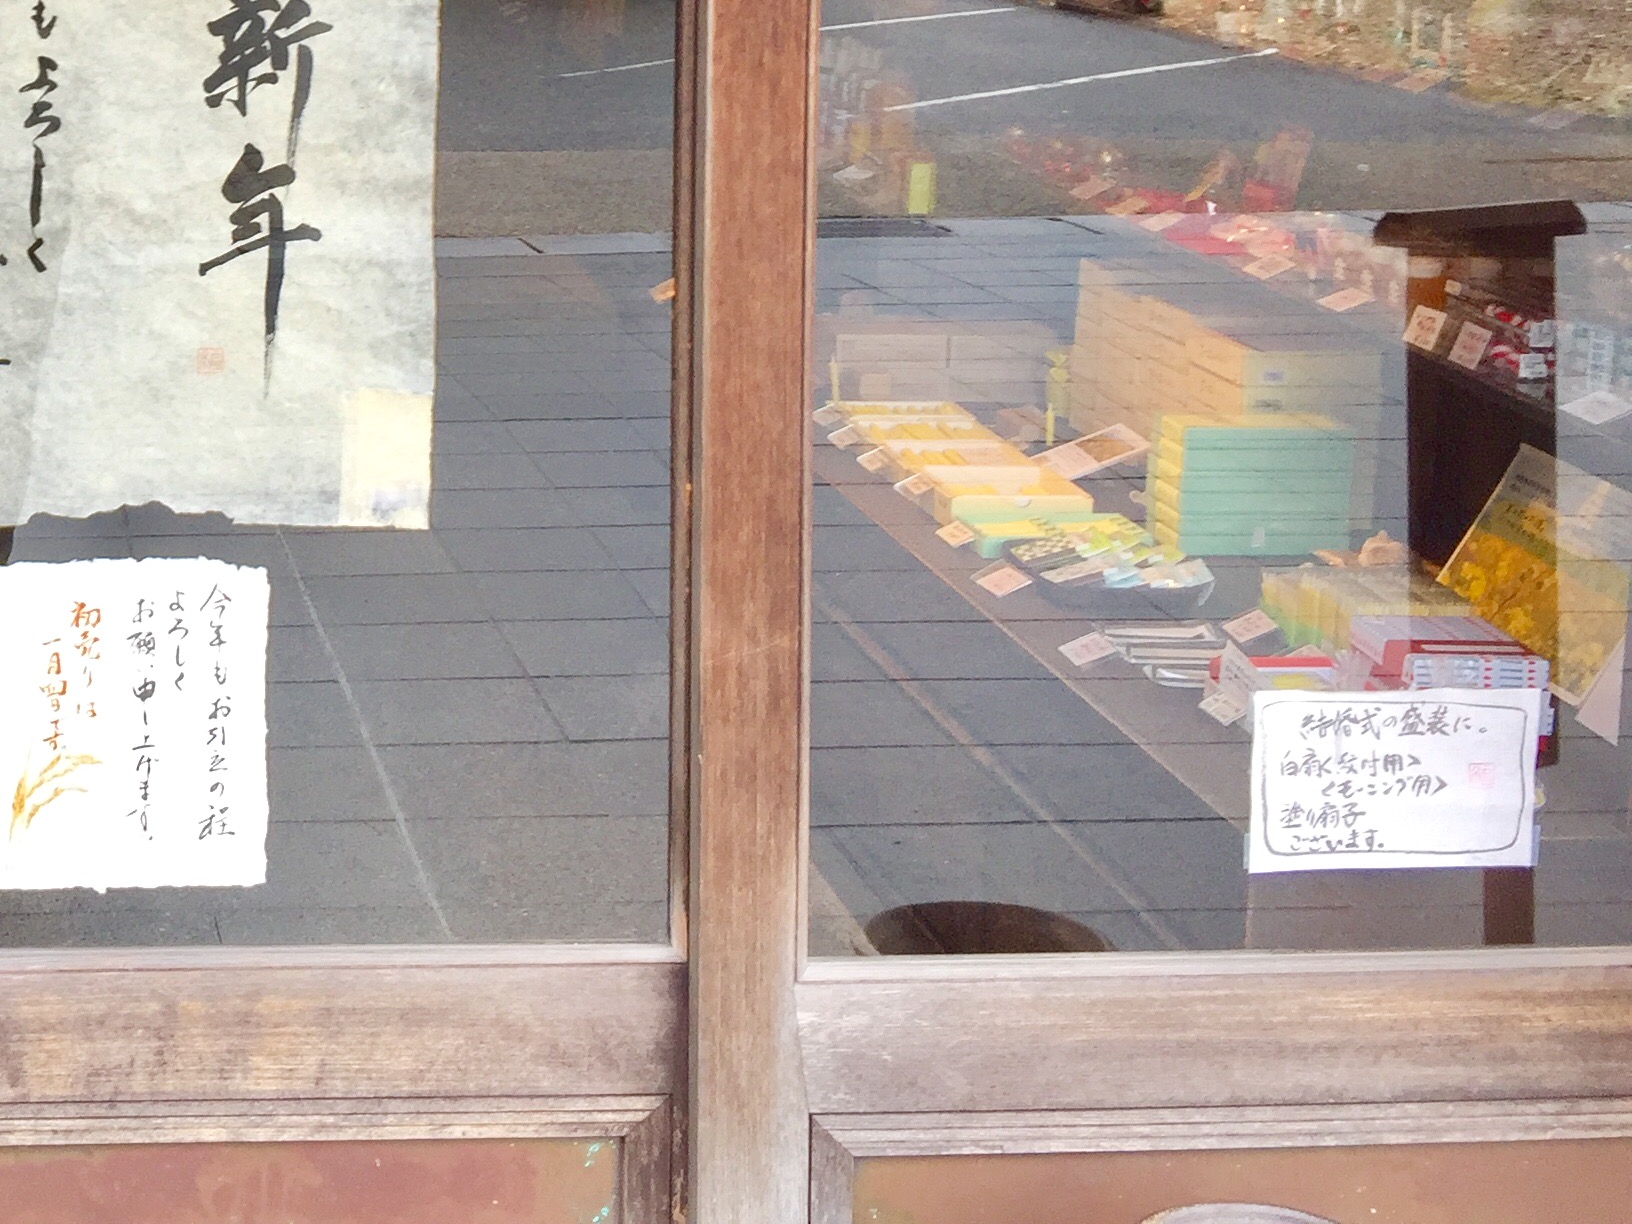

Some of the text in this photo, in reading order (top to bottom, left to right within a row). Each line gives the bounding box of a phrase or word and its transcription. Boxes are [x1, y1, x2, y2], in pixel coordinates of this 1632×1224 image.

[71, 601, 101, 718] 初売りは
[168, 591, 189, 692] よろしく
[198, 584, 235, 840] 今年もお引立の程
[1280, 802, 1366, 829] 塗り扇子
[1290, 829, 1384, 852] ございます。
